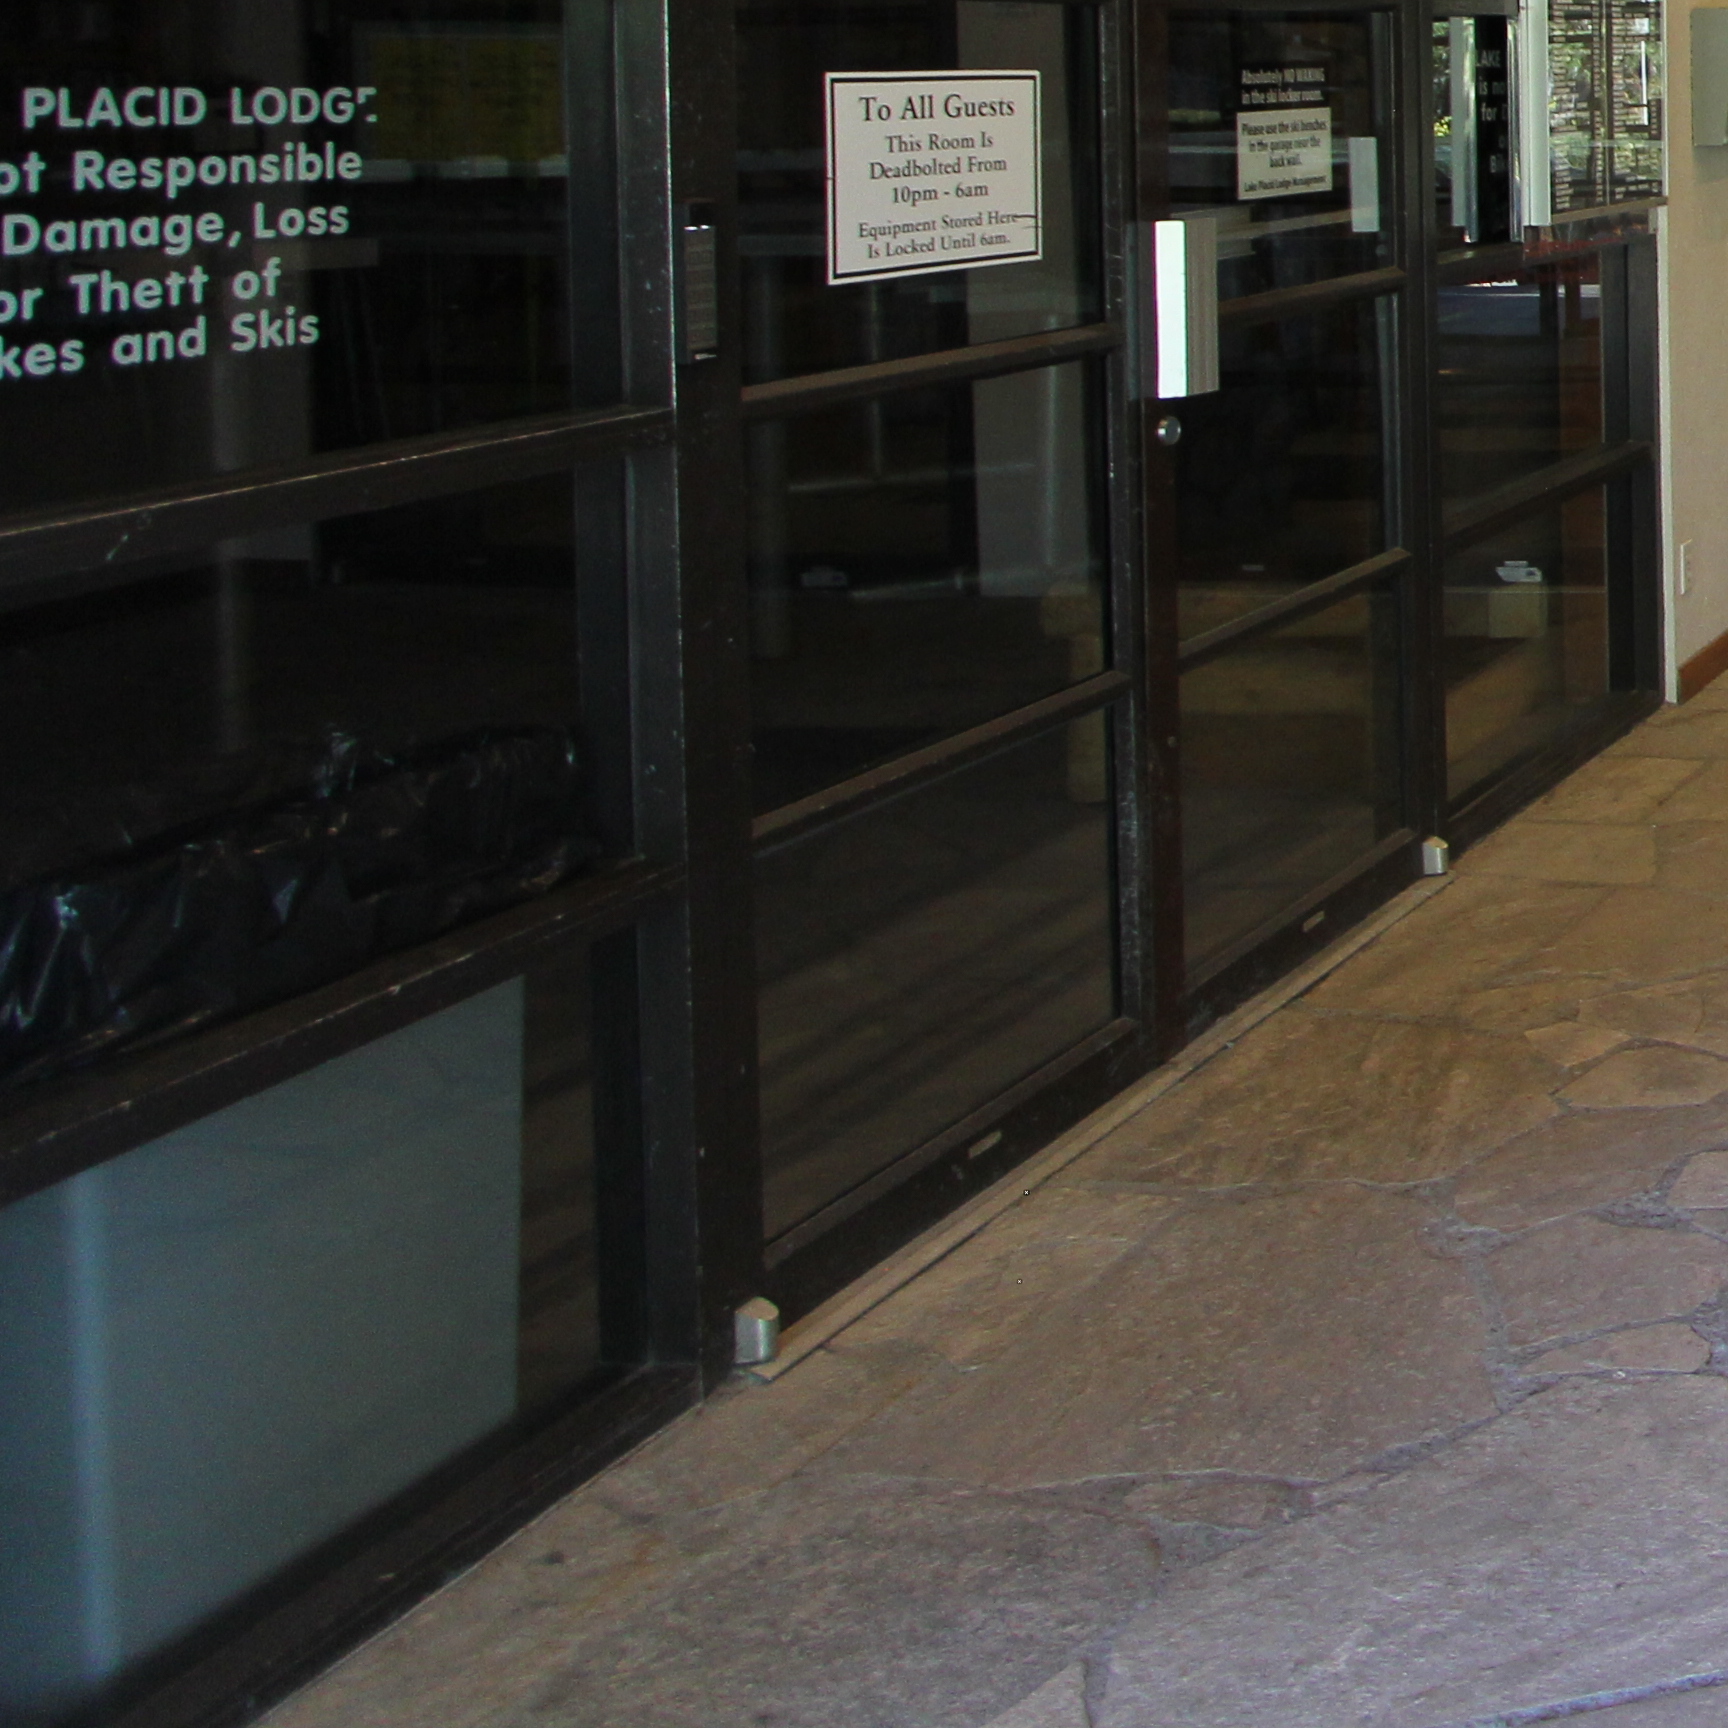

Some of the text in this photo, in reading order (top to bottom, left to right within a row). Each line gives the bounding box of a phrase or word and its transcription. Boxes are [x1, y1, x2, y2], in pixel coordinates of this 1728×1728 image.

[22, 87, 208, 129] PLACID
[859, 93, 1015, 122] To All Guests
[886, 131, 994, 153] This Room Is
[72, 141, 363, 200] Responsible
[869, 154, 1007, 180] Deadbolted From
[893, 186, 938, 207] 10pm
[956, 182, 989, 199] 6am
[1, 202, 349, 256] Damage, Loss
[859, 210, 1018, 241] Equipment Stored Here
[867, 232, 1010, 259] Is Locked Until 6am.
[231, 257, 282, 300] of
[112, 315, 207, 365] and
[231, 306, 319, 352] Skis
